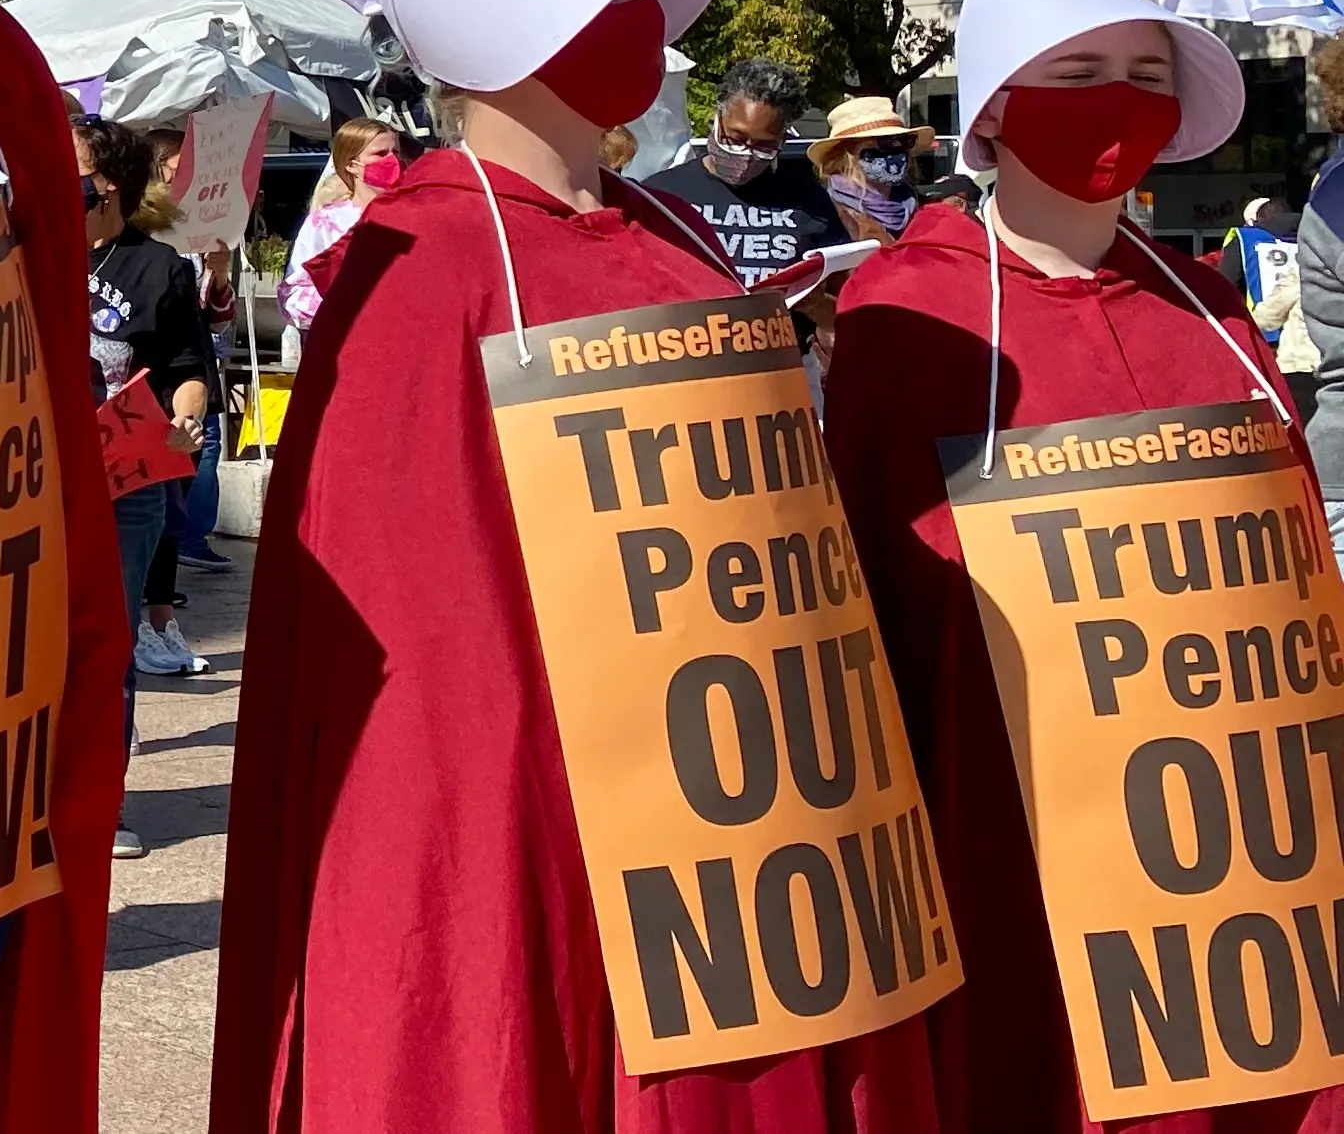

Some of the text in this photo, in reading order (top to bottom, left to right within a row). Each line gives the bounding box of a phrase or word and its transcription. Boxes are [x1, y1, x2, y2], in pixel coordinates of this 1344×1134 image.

[197, 181, 229, 202] OFF
[691, 204, 797, 228] LACK
[616, 520, 864, 636] Pence
[1074, 608, 1344, 718] Pence
[664, 626, 894, 827] OUT
[622, 804, 950, 1041] NOW!
